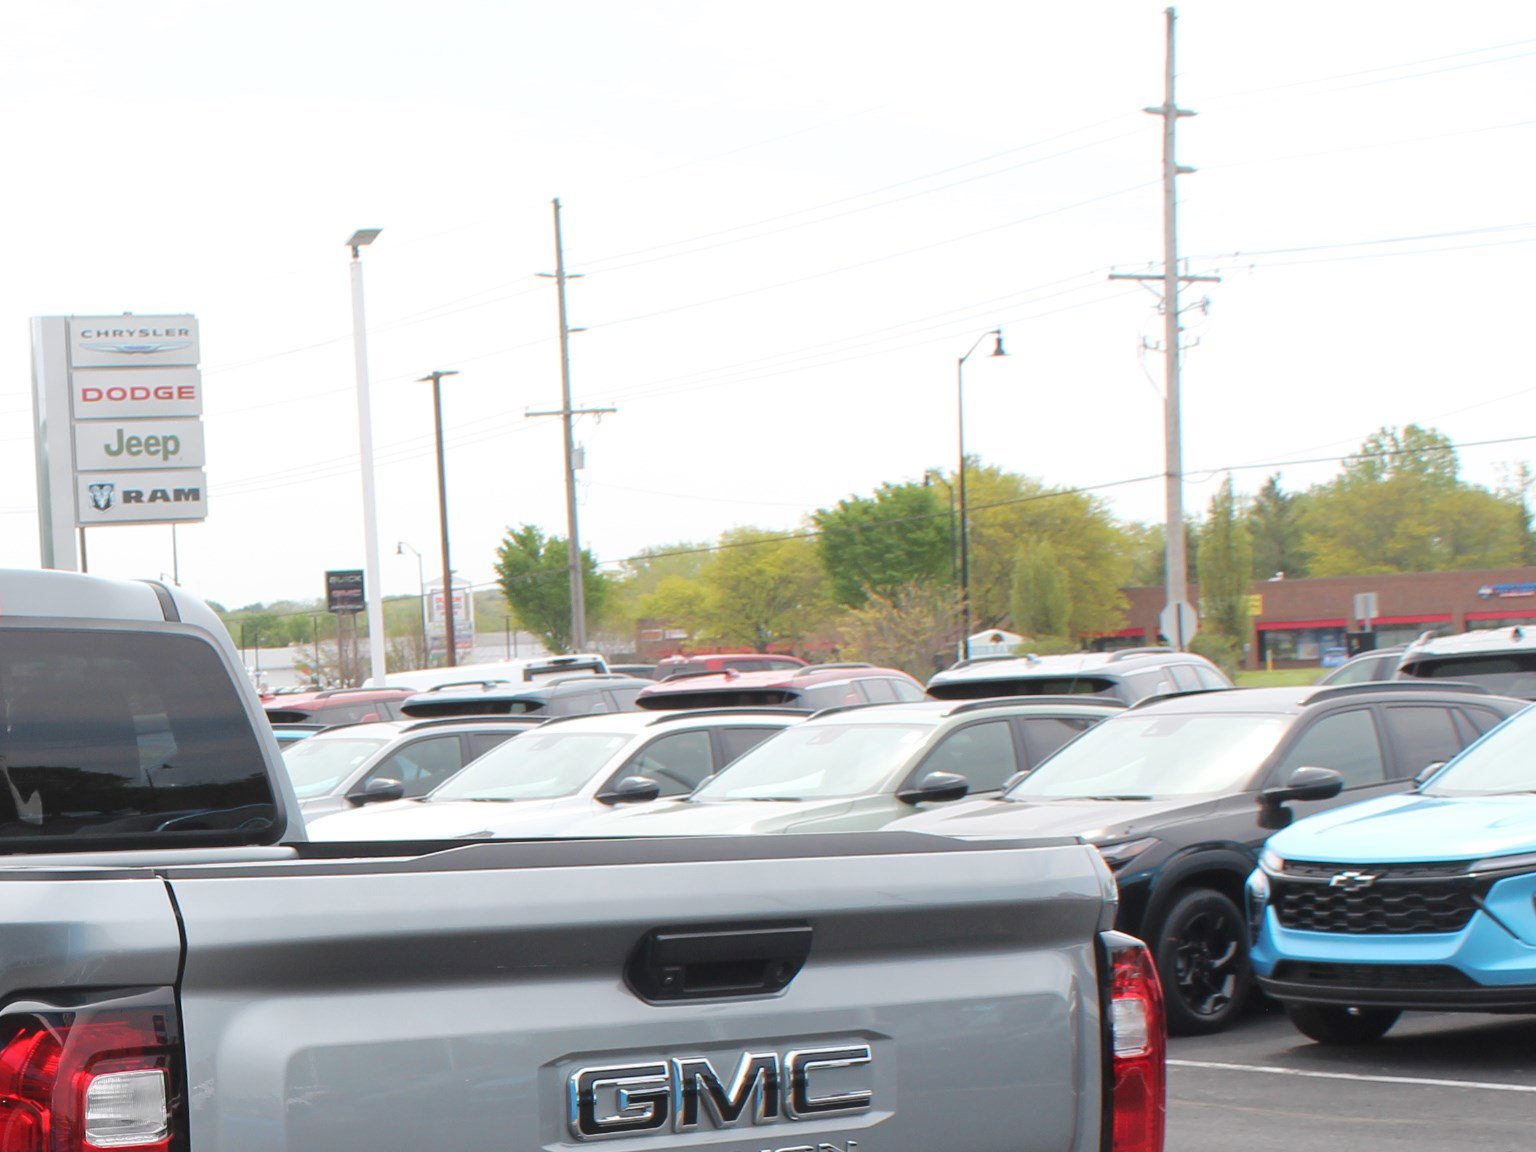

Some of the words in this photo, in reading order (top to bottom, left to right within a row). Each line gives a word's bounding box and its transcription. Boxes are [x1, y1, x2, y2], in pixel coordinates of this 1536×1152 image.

[81, 328, 190, 339] CHRYSLER
[81, 385, 195, 402] DODGE
[104, 428, 181, 461] Jeep
[122, 488, 201, 504] RAM
[567, 1043, 872, 1142] GMC
